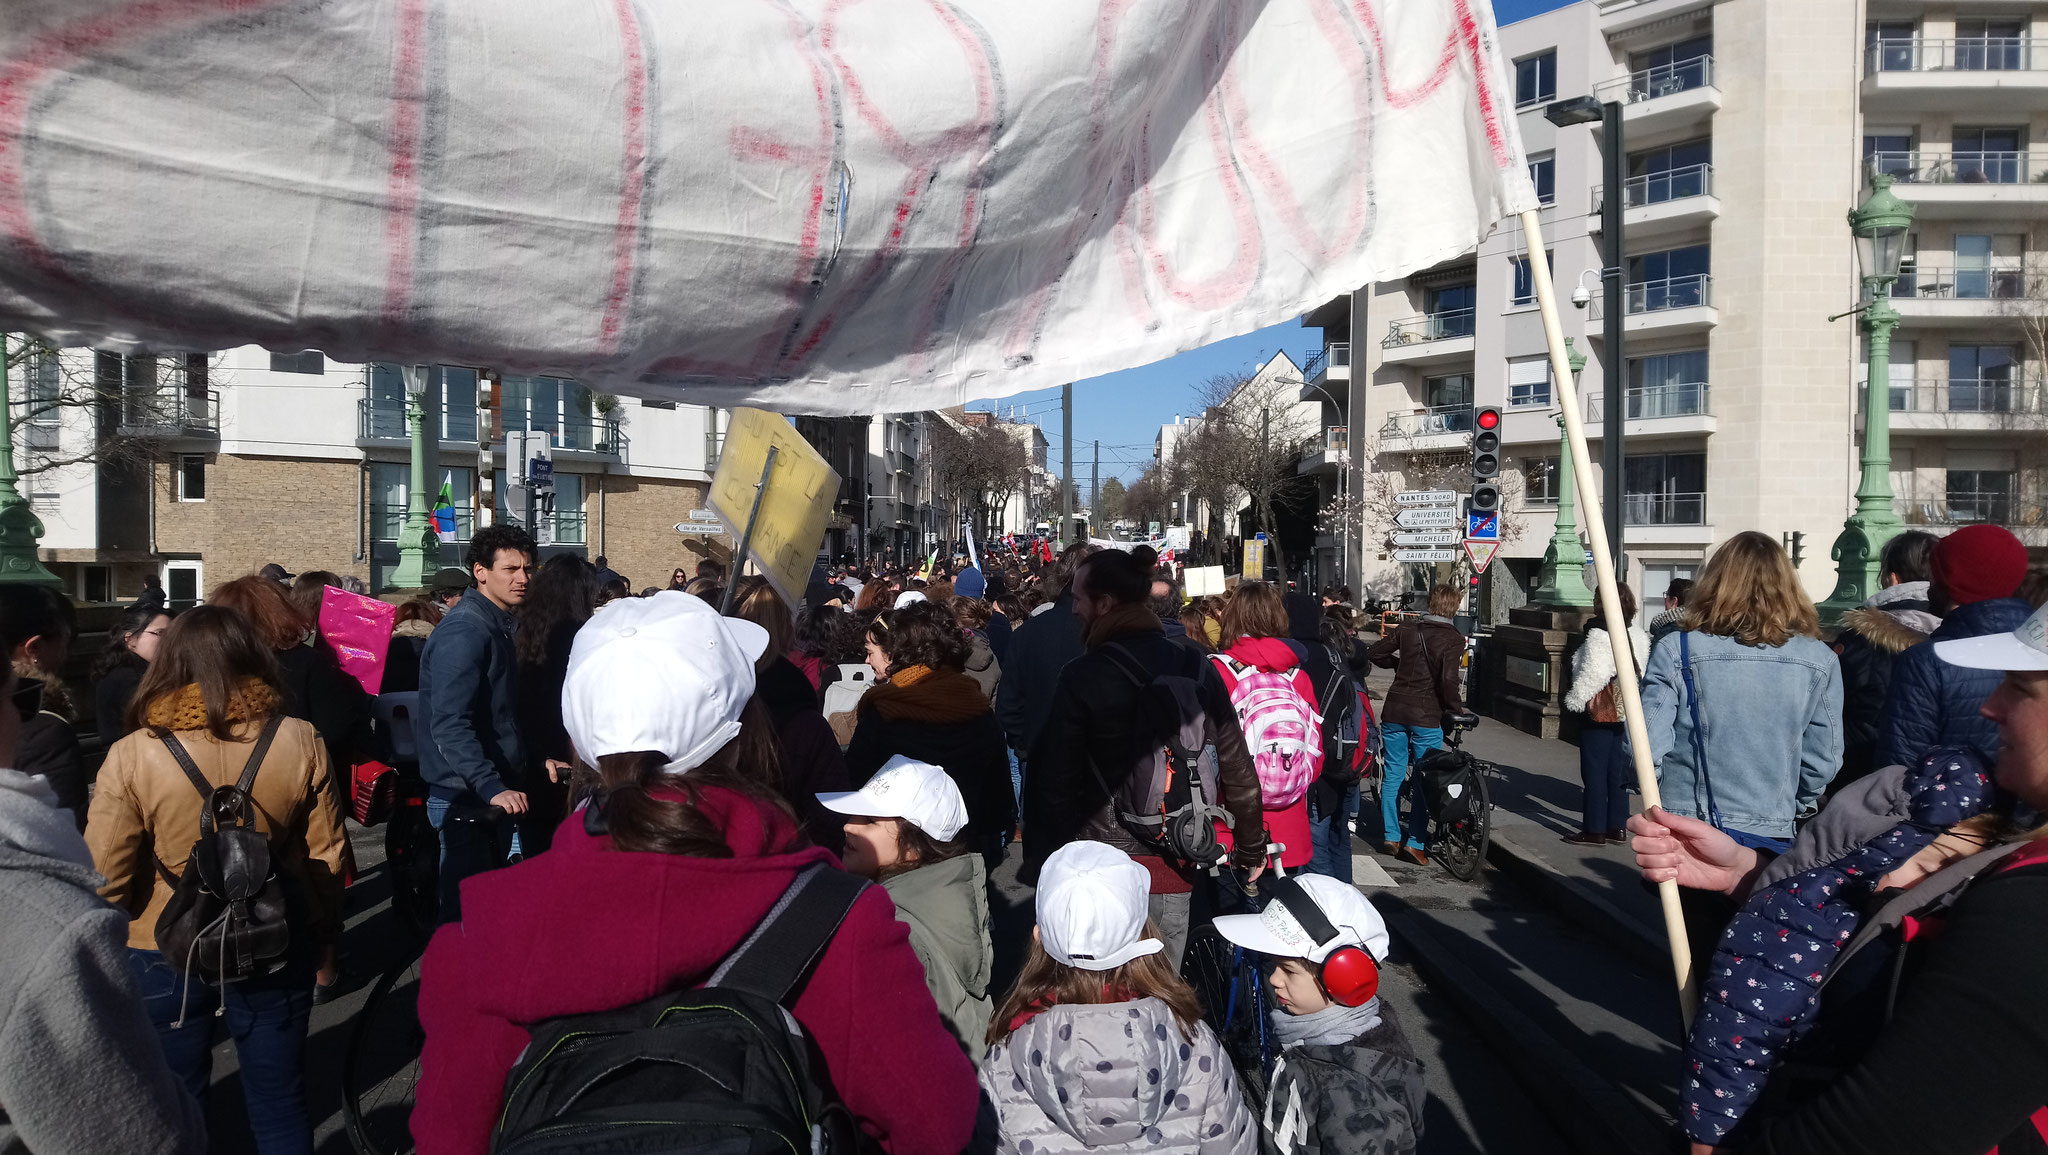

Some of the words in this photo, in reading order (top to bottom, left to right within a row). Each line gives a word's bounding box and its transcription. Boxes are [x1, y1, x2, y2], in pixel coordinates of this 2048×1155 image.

[803, 472, 826, 510] LA
[1400, 494, 1430, 502] NANTES
[1430, 551, 1450, 559] FÉLIX
